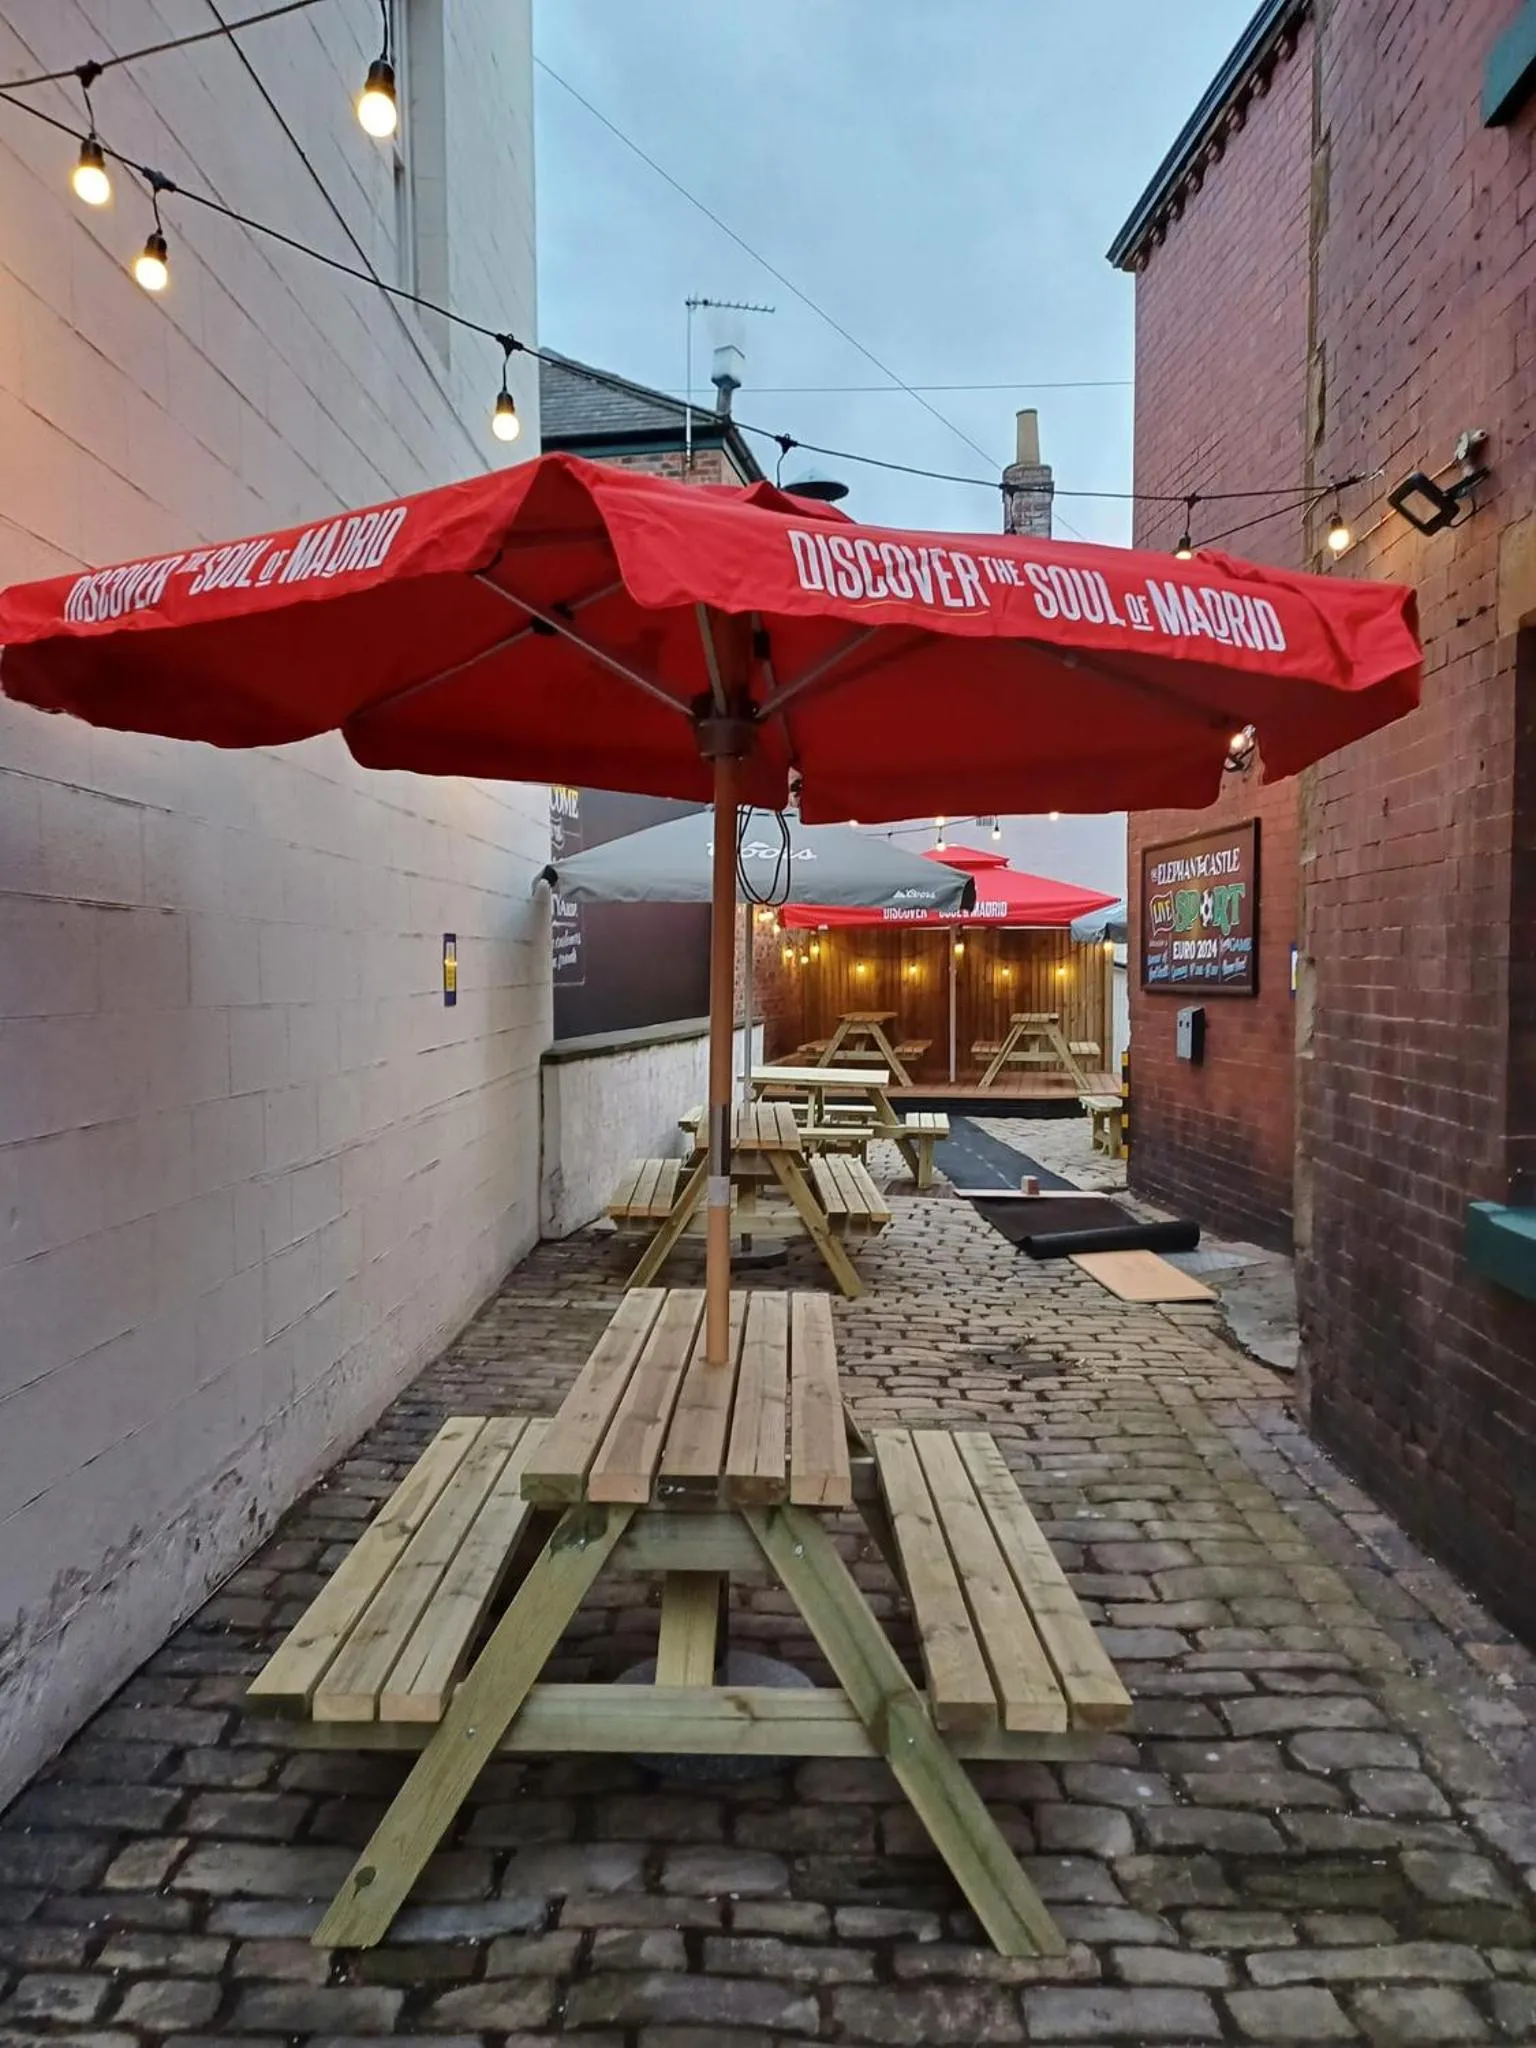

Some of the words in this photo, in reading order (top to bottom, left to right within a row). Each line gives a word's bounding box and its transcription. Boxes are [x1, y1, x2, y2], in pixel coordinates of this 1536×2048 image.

[64, 555, 178, 623] DISCOVER
[189, 538, 275, 596] SOUL
[255, 549, 290, 588] OF
[278, 506, 408, 585] MADRID
[787, 530, 991, 609] DISCOVER
[979, 556, 1026, 588] THE
[1022, 563, 1127, 627] SOUL
[1125, 594, 1154, 632] OF
[1145, 579, 1287, 652] MADRID
[1172, 940, 1195, 960] EURO
[1196, 938, 1218, 959] 2024
